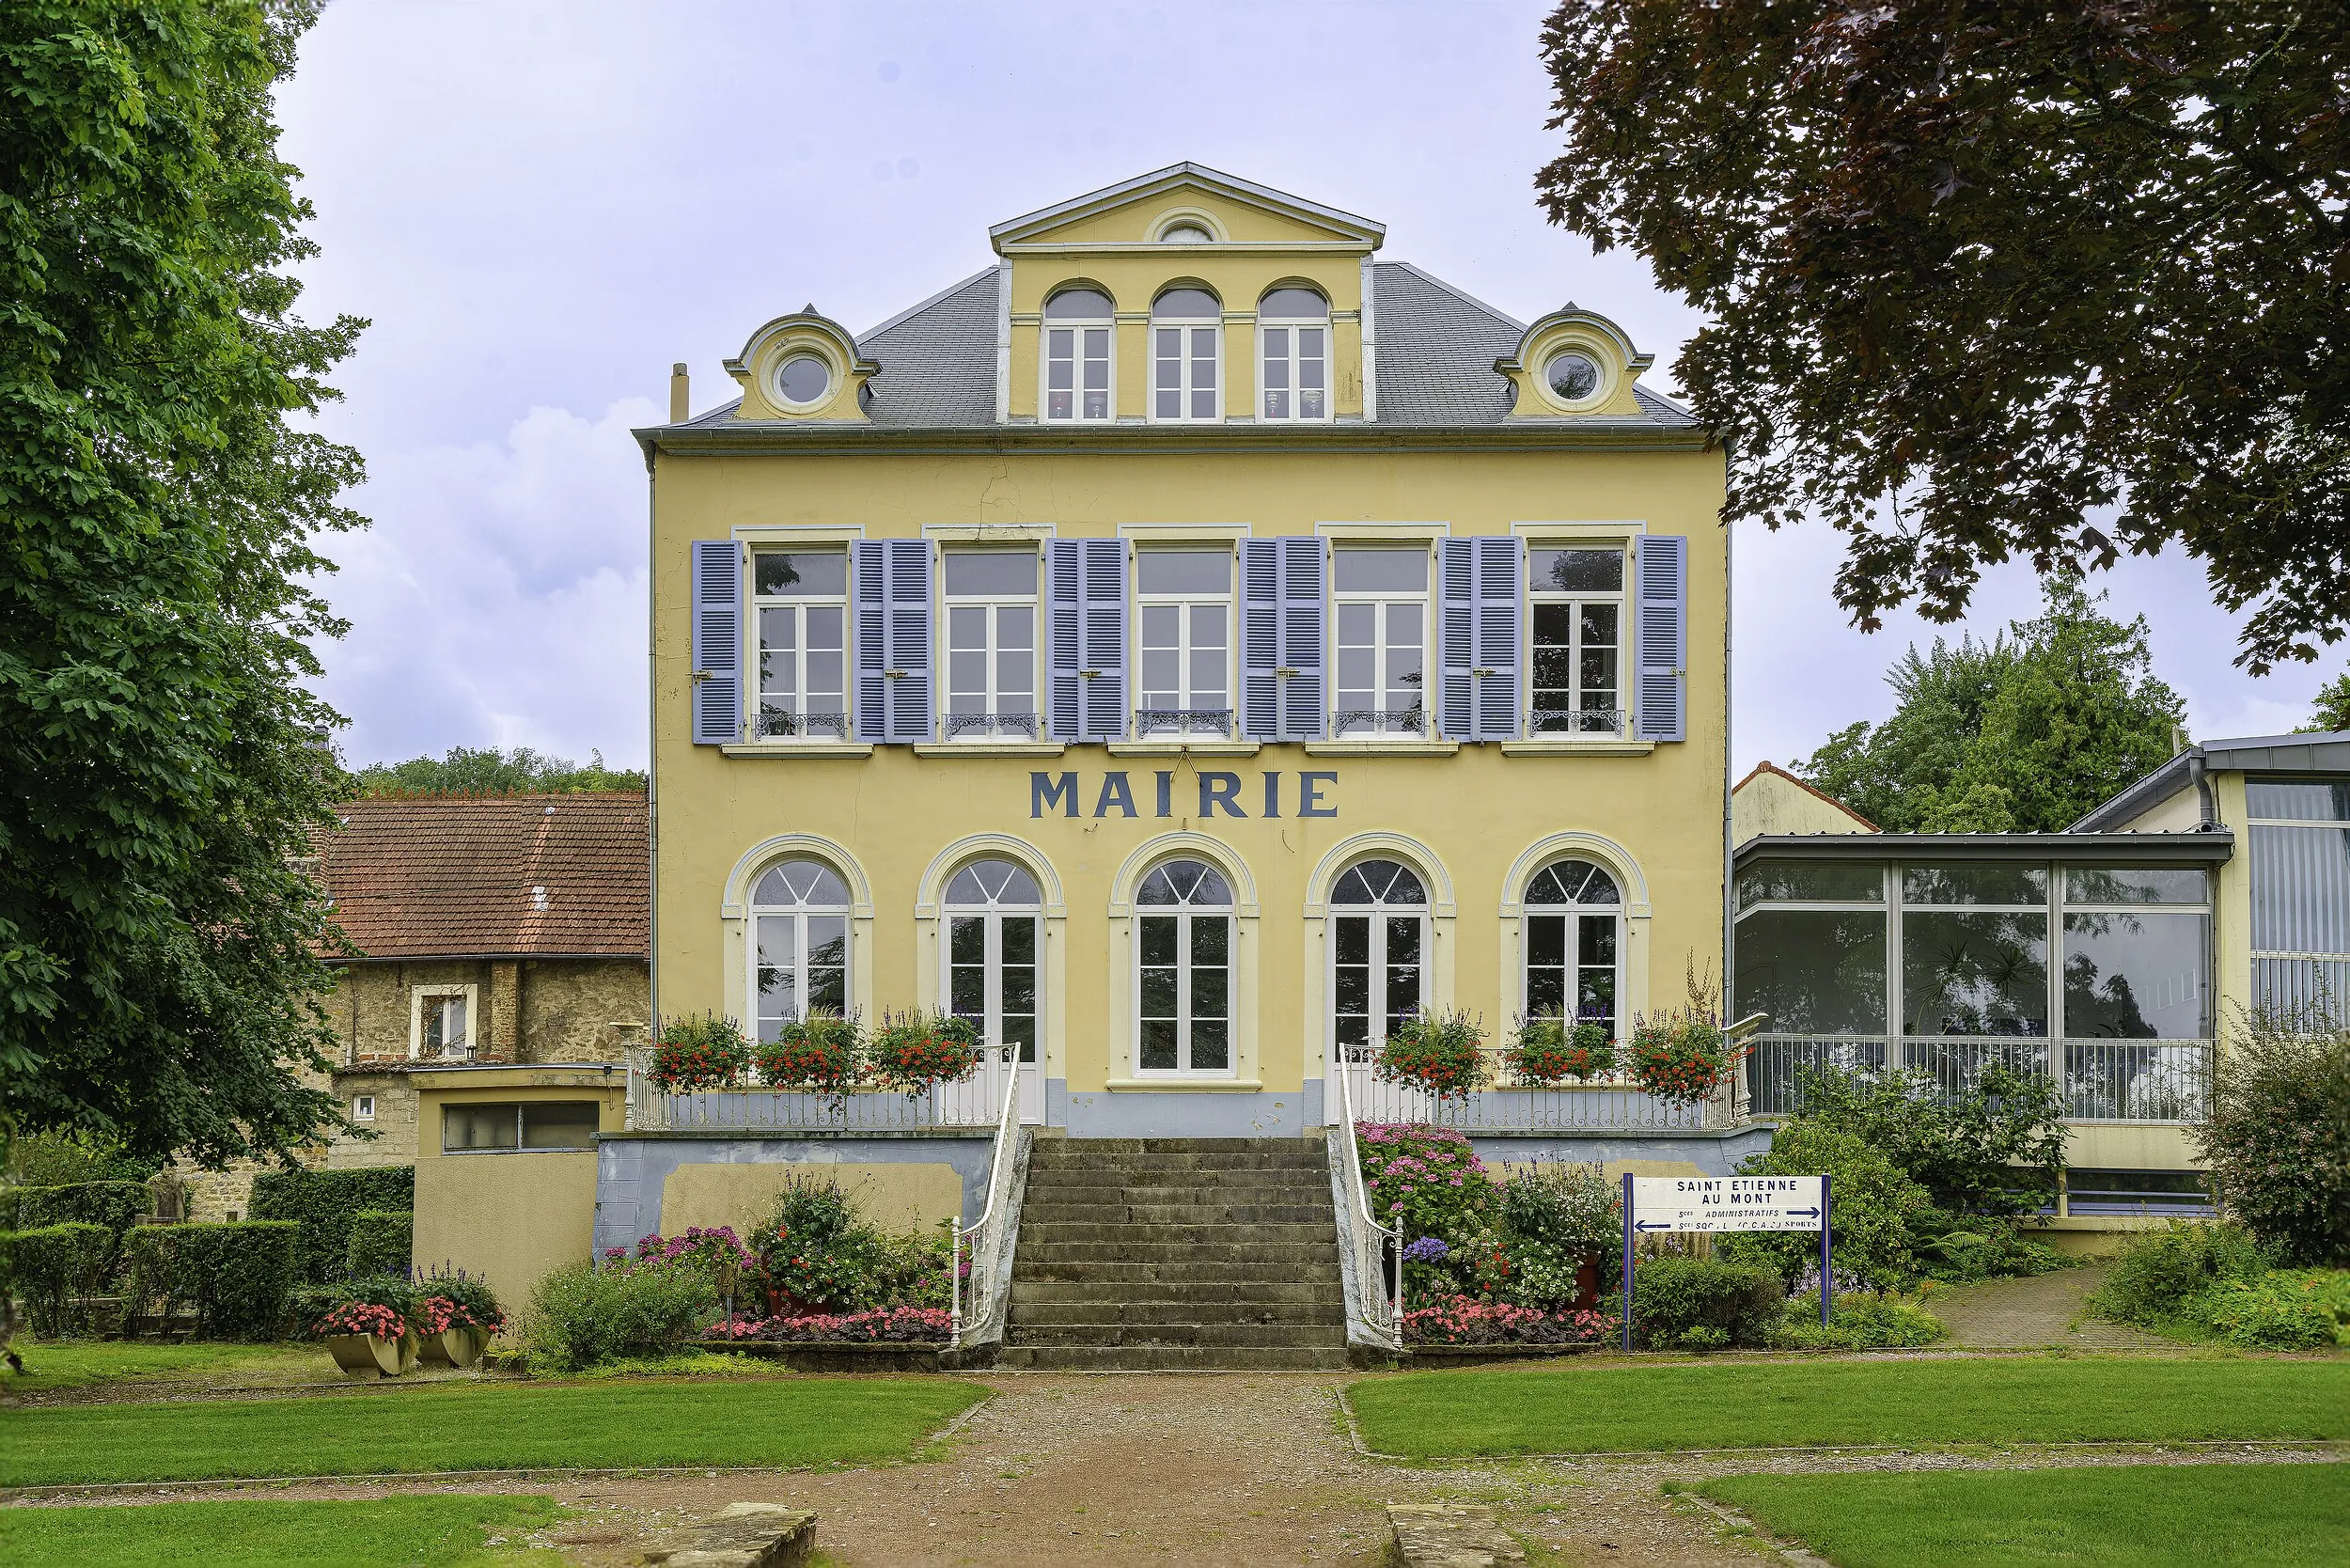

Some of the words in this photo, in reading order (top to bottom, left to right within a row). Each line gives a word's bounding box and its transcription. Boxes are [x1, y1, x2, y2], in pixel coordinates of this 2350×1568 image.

[1029, 771, 1339, 818] MAIRIE
[1677, 1181, 1722, 1192] SAINT
[1731, 1180, 1797, 1191] ETIENNE
[1702, 1194, 1721, 1204] AU
[1731, 1193, 1772, 1204] MONT
[1705, 1210, 1779, 1218] ADMINISTRATIFS
